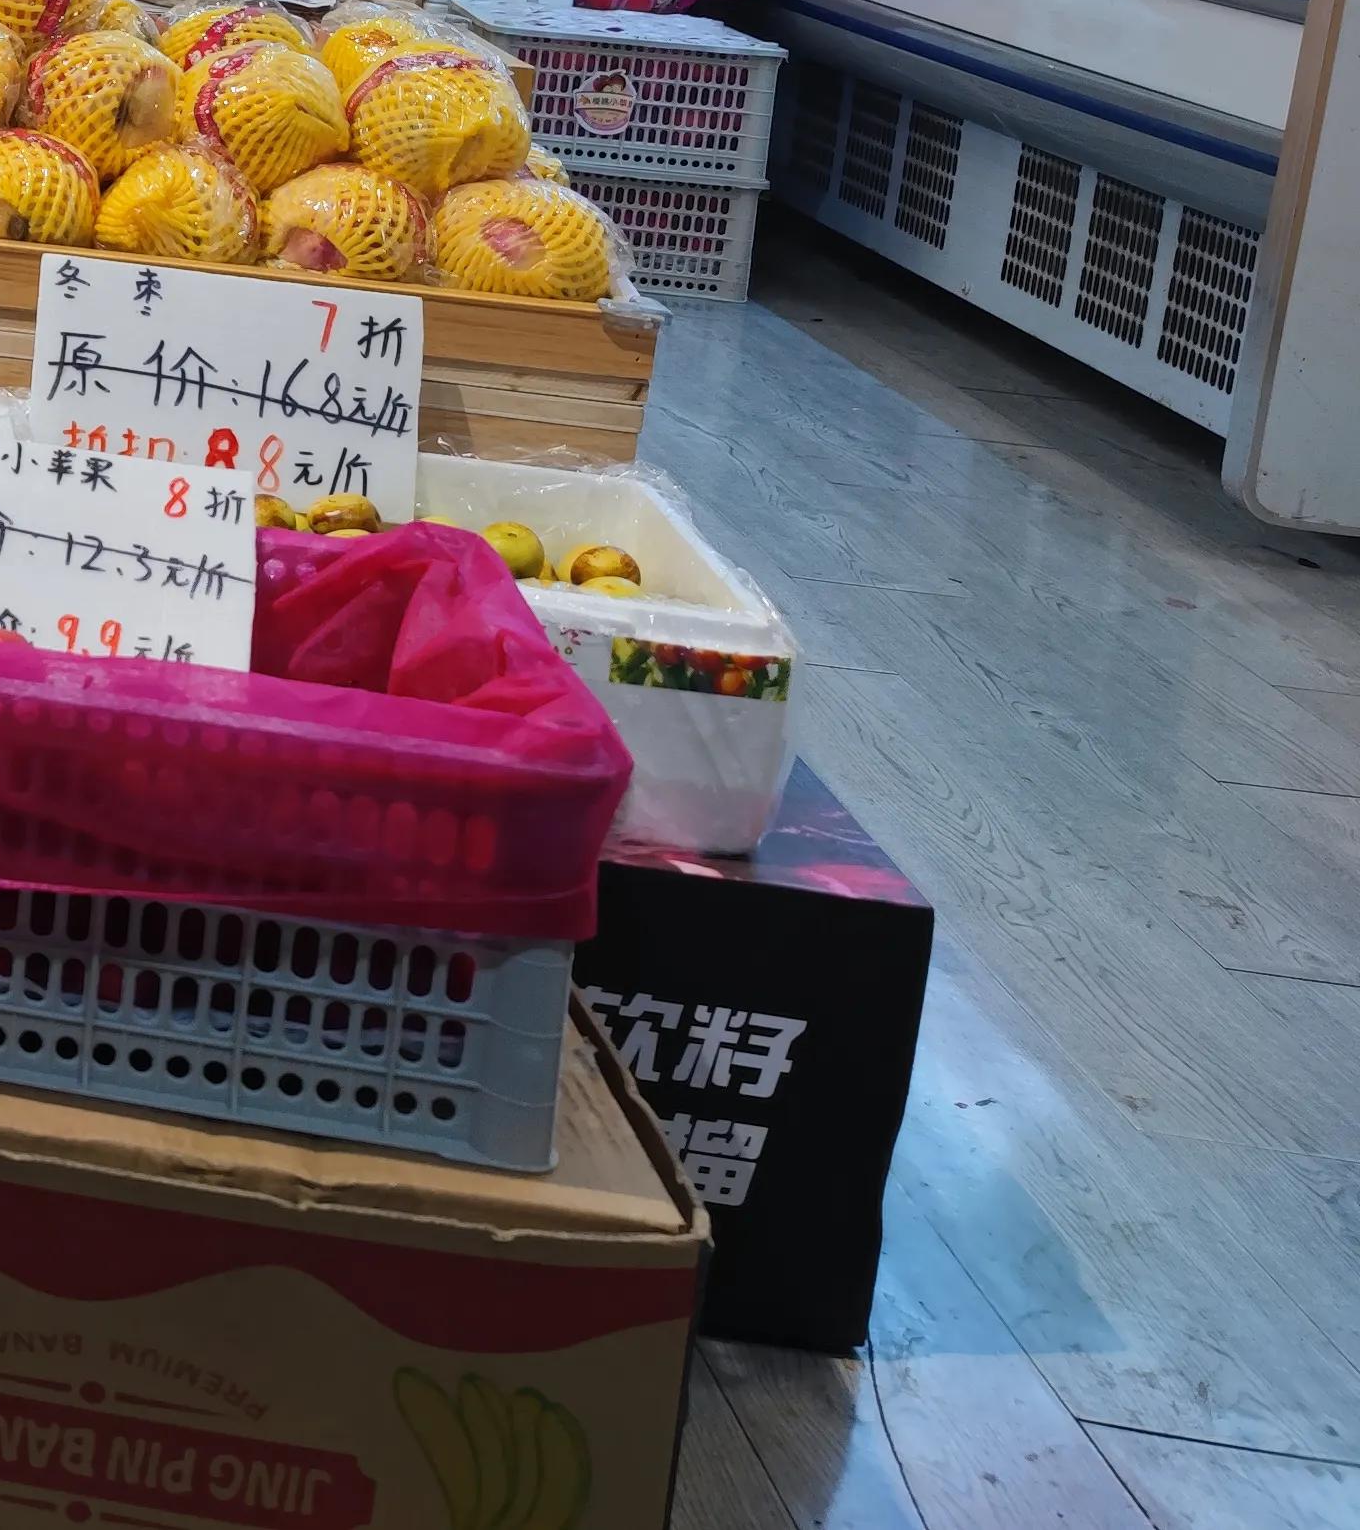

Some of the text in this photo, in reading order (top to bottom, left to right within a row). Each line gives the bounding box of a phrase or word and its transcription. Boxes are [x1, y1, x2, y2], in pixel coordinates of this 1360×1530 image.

[54, 259, 164, 317] 冬枣
[311, 299, 408, 367] 7折
[163, 476, 247, 526] 8折
[105, 1338, 271, 1423] PREMIUM
[107, 1437, 199, 1496] PIN
[207, 1450, 332, 1517] JING
